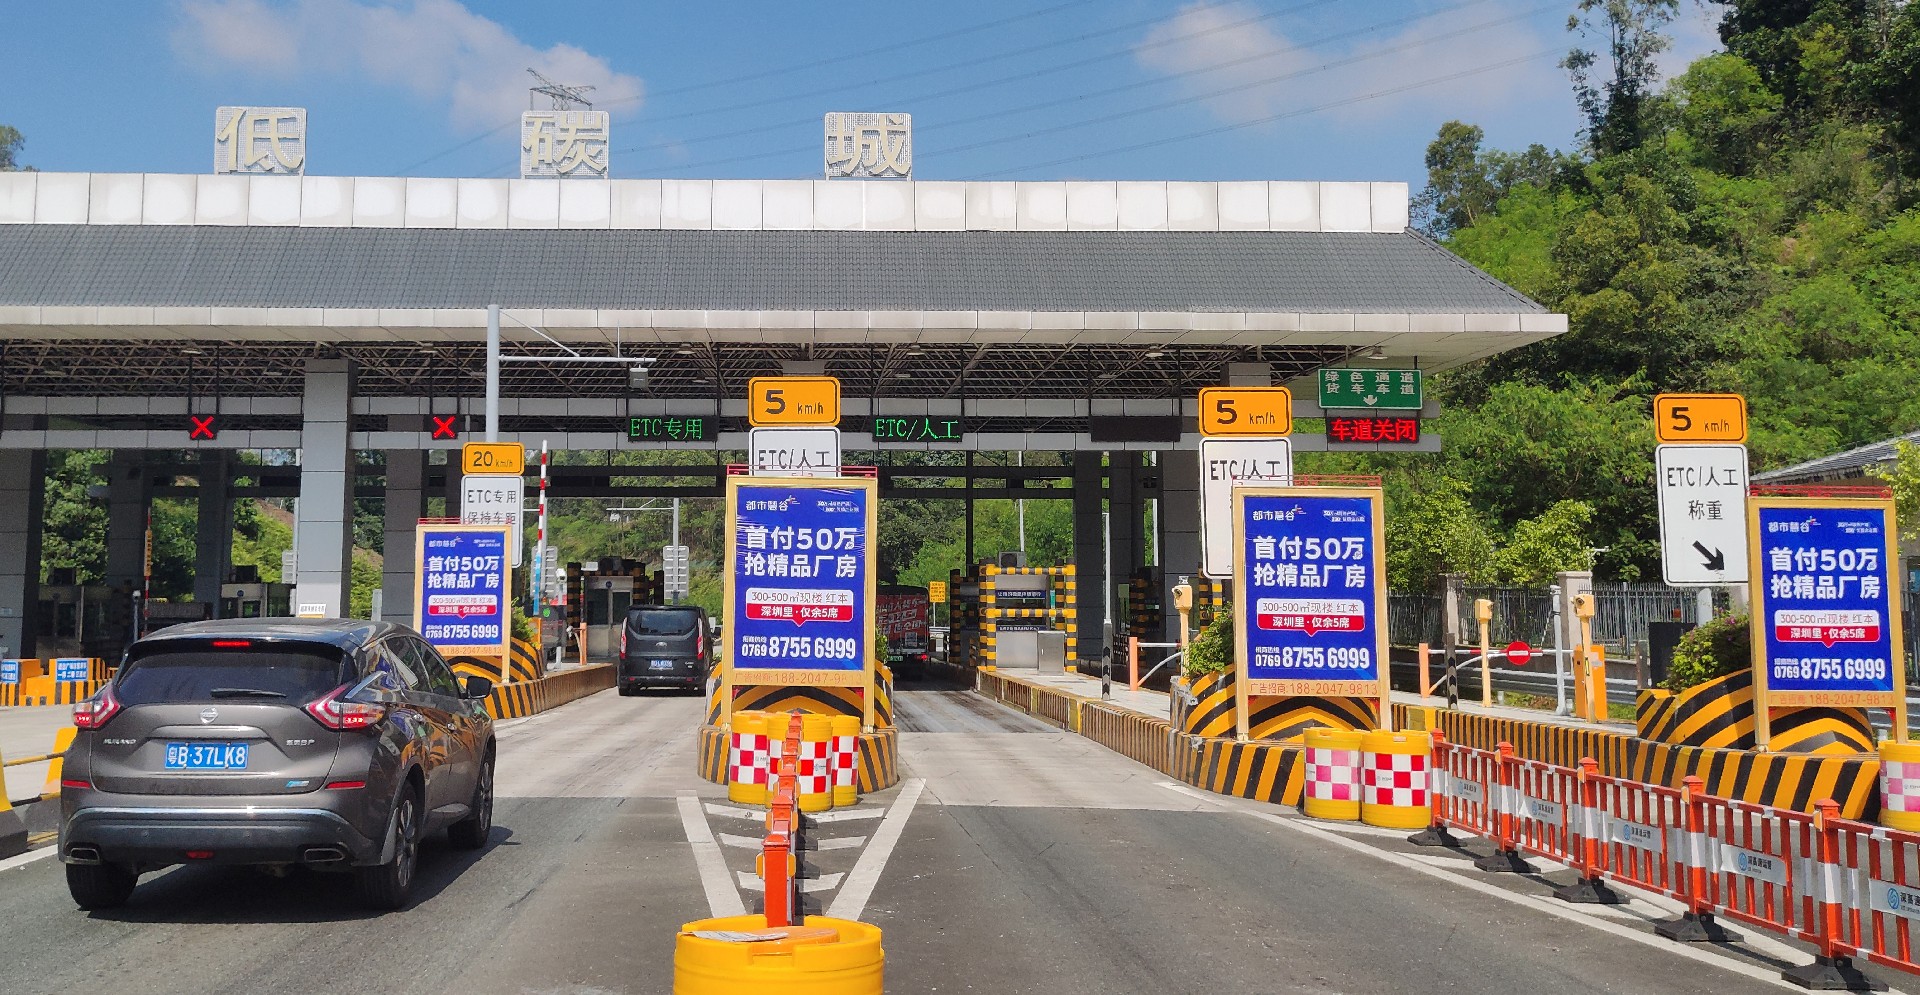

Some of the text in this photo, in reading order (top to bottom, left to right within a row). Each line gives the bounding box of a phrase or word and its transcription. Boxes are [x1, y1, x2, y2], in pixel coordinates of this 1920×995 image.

[1325, 371, 1414, 383] 绿色通道
[1325, 383, 1415, 395] 货车车道
[765, 389, 823, 415] 5 km/h
[1216, 400, 1275, 425] 5 km/h
[630, 418, 703, 440] ETC专用
[875, 418, 961, 440] ETC/人工
[1671, 406, 1730, 432] 5 km/h
[1329, 418, 1417, 442] 车道关闭
[473, 451, 493, 467] 20
[758, 449, 831, 470] ETC/人工
[1209, 459, 1281, 480] ETC/人工
[1667, 466, 1739, 487] ETC/人工
[467, 489, 517, 504] ETC专用
[467, 511, 517, 525] 保持车距
[1688, 500, 1723, 521] 称重
[745, 526, 857, 550] 首付50万
[1253, 535, 1365, 560] 首付50万
[428, 555, 500, 571] 首付50万
[745, 553, 857, 578] 抢精品厂房
[1769, 547, 1878, 572] 首付50万
[428, 573, 500, 589] 抢精品厂房
[1254, 563, 1366, 588] 抢精品厂房
[1770, 574, 1881, 600] 抢精品厂房
[826, 592, 848, 604] 红本
[1336, 603, 1359, 613] 红本
[1852, 614, 1873, 624] 红本
[425, 624, 499, 639] 0769 8755 6999
[741, 636, 856, 659] 0769 8755 6999
[1255, 647, 1370, 669] 0769 8755 6999
[1774, 658, 1886, 680] 0769 8755 6999
